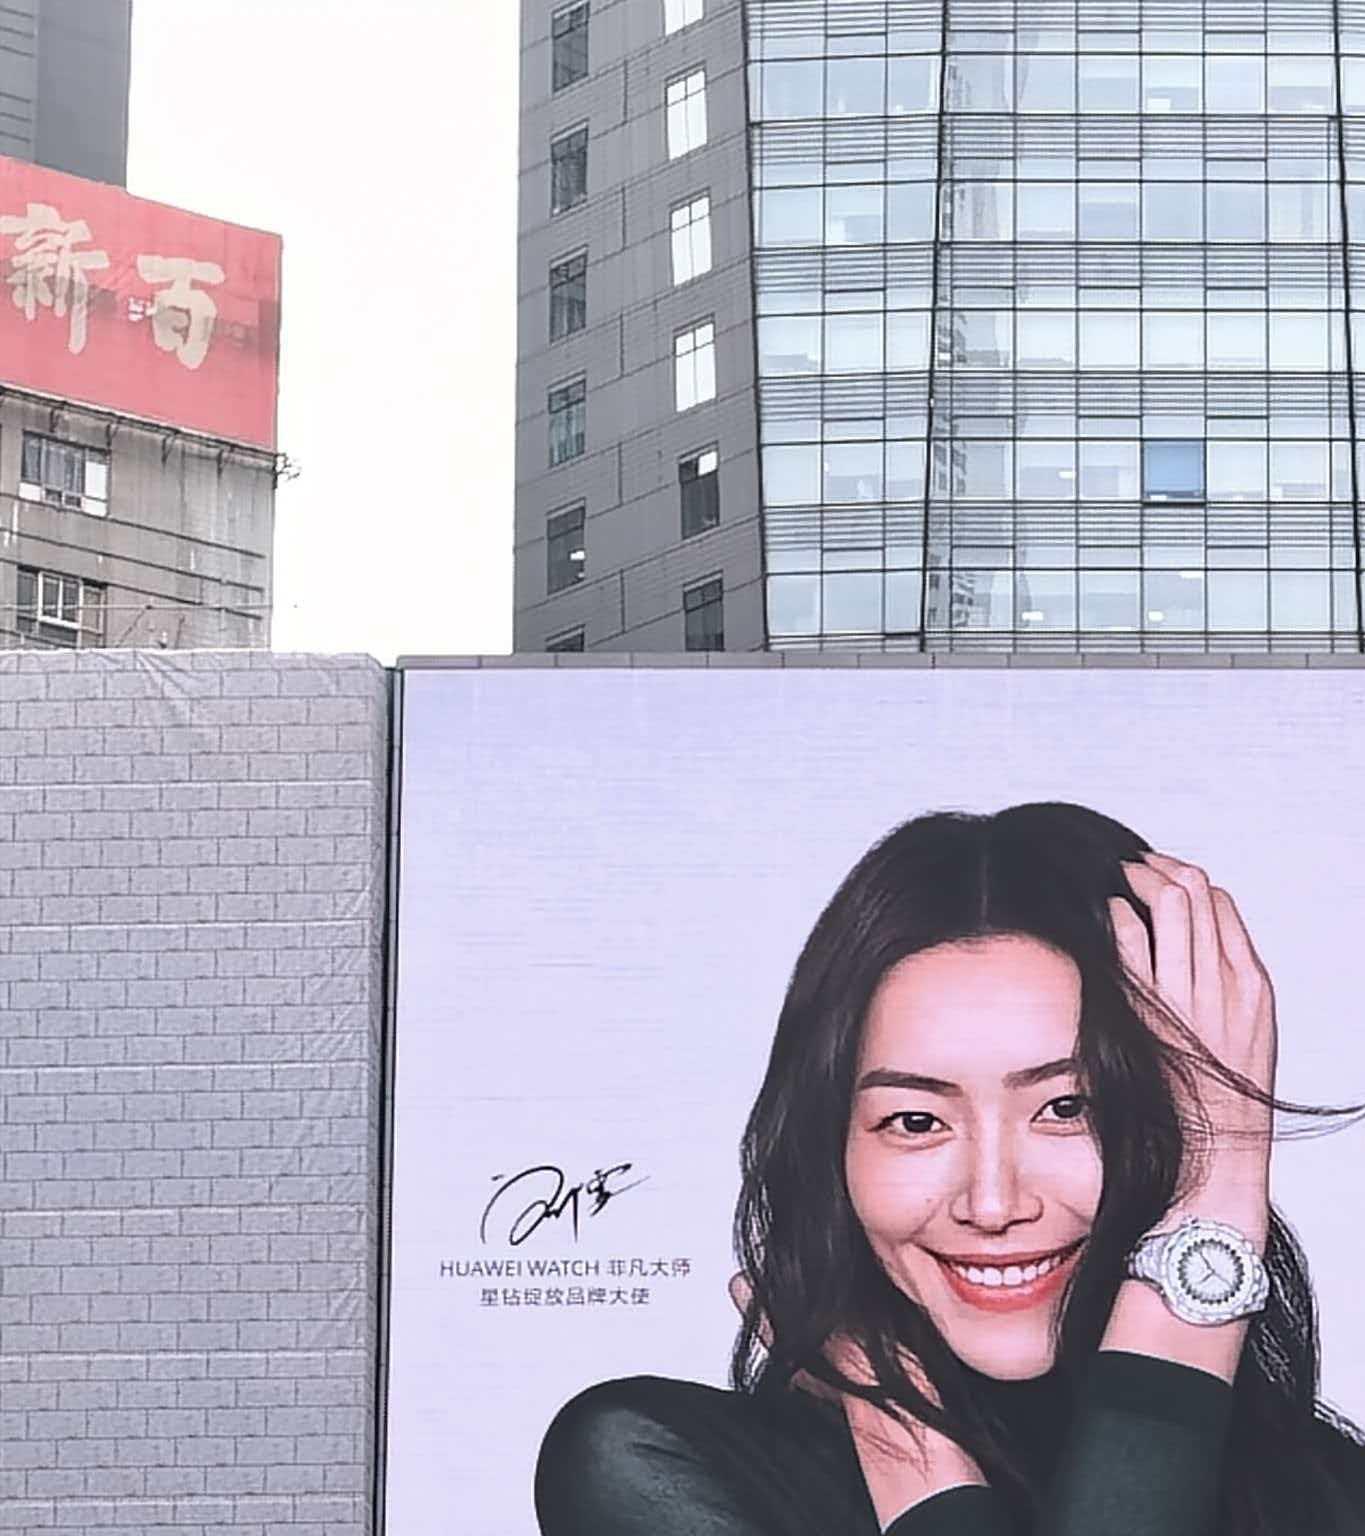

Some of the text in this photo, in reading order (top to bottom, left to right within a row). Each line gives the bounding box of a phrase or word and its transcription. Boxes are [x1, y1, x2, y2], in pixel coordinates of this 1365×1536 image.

[0, 202, 226, 370] 新百
[439, 1257, 692, 1278] HUAWEI WATCH 非凡大师
[480, 1286, 650, 1307] 星钻绽放品牌大使
